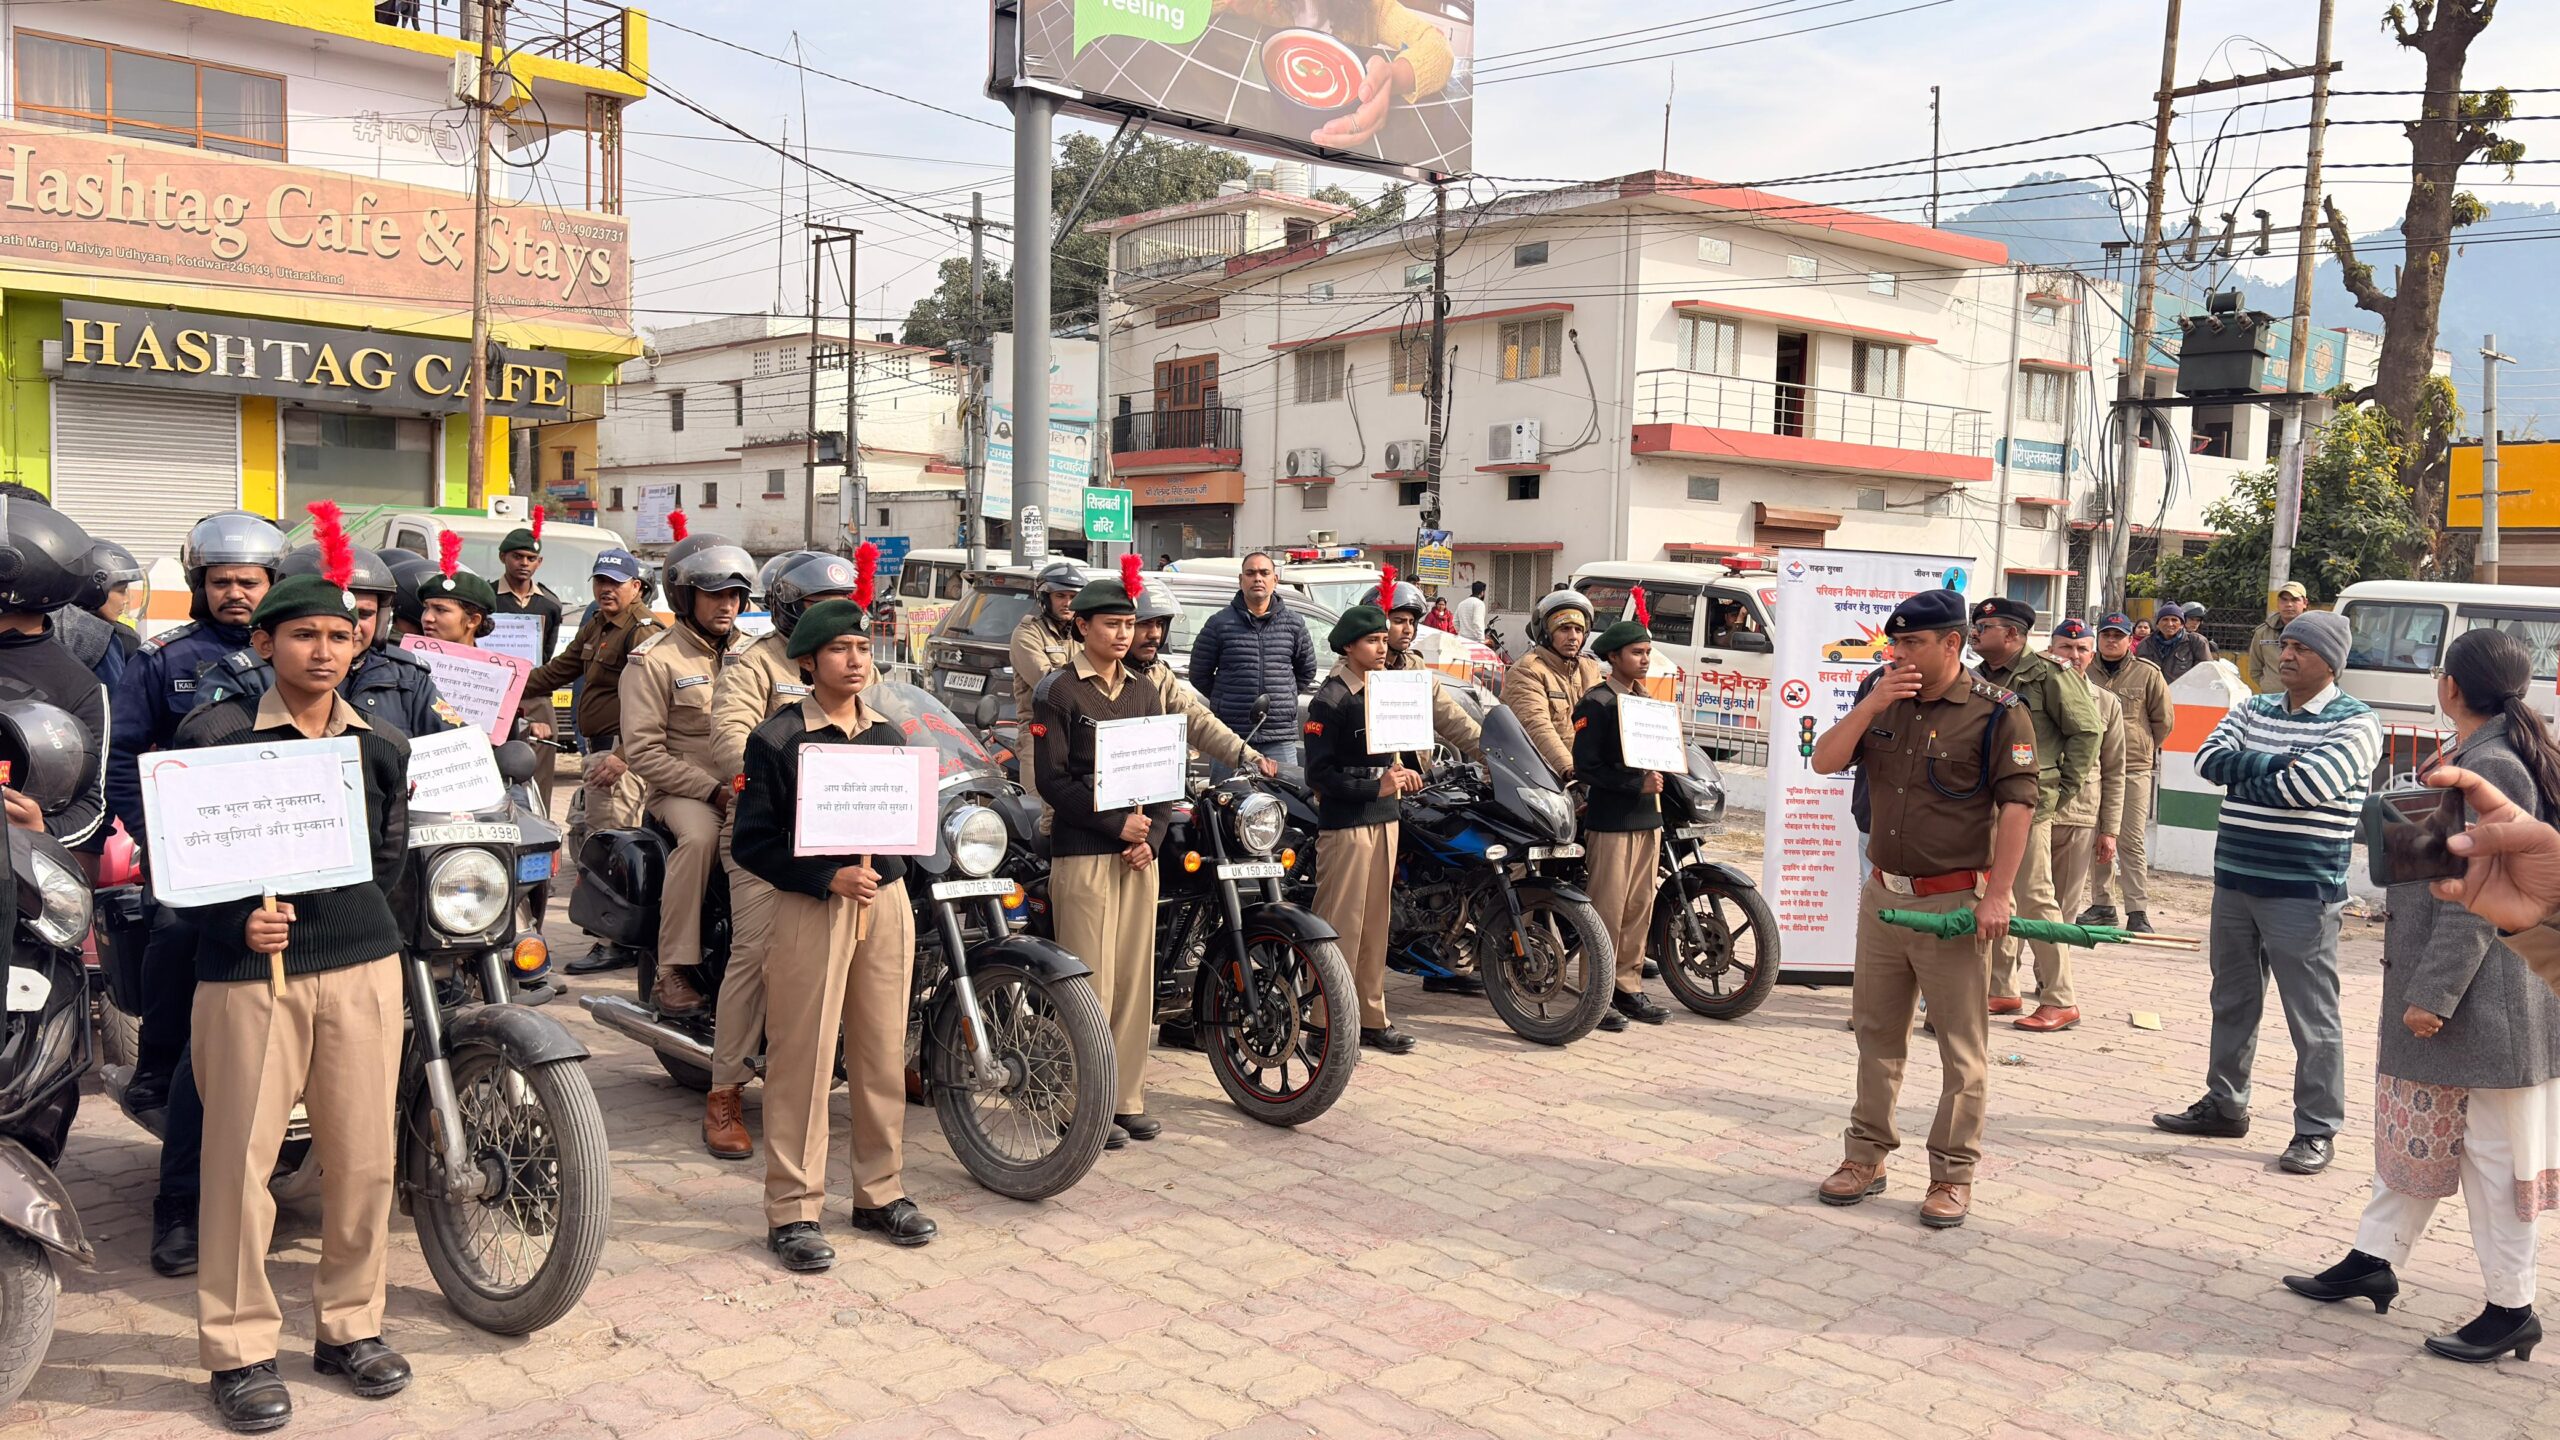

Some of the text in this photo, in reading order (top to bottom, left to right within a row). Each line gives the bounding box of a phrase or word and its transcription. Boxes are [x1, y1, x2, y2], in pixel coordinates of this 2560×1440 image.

[1103, 0, 1184, 30] eeling
[386, 121, 456, 150] HOTEL
[0, 143, 613, 300] Hashtag Cafe & Stays
[558, 221, 624, 243] 9149023731
[27, 236, 62, 252] Marg,
[65, 240, 113, 257] Malviya
[115, 247, 172, 266] Udhyaan,
[176, 254, 273, 278] Kotdwar-246149,
[276, 266, 344, 285] Uttarakhand
[65, 318, 397, 390] HASHTAG
[1093, 516, 1115, 534] मंदिर
[599, 556, 622, 566] POLICE
[1827, 565, 1843, 576] सुरक्षा
[1914, 569, 1930, 578] जीवन
[1816, 585, 1895, 601] परिवहन विभाग कोटद्वार
[1859, 603, 1870, 615] हेतु
[1873, 604, 1892, 616] सुरक्षा
[1701, 670, 1771, 691] पेट्रोल
[1818, 668, 1853, 683] हादसों
[557, 694, 569, 703] HR
[1306, 722, 1320, 731] NCC
[824, 784, 840, 793] आप
[869, 783, 889, 793] अपनी
[197, 805, 221, 819] एक
[225, 801, 249, 819] भूल
[254, 795, 273, 810] करे
[816, 801, 832, 811] तभी
[834, 801, 851, 812] होगी
[852, 801, 876, 811] परिवार
[877, 801, 888, 811] की
[184, 830, 211, 847] छीने
[214, 824, 263, 847] खुशियाँ
[266, 820, 290, 836] और
[421, 827, 439, 842] UK
[1232, 865, 1282, 877] UK 15D 3034
